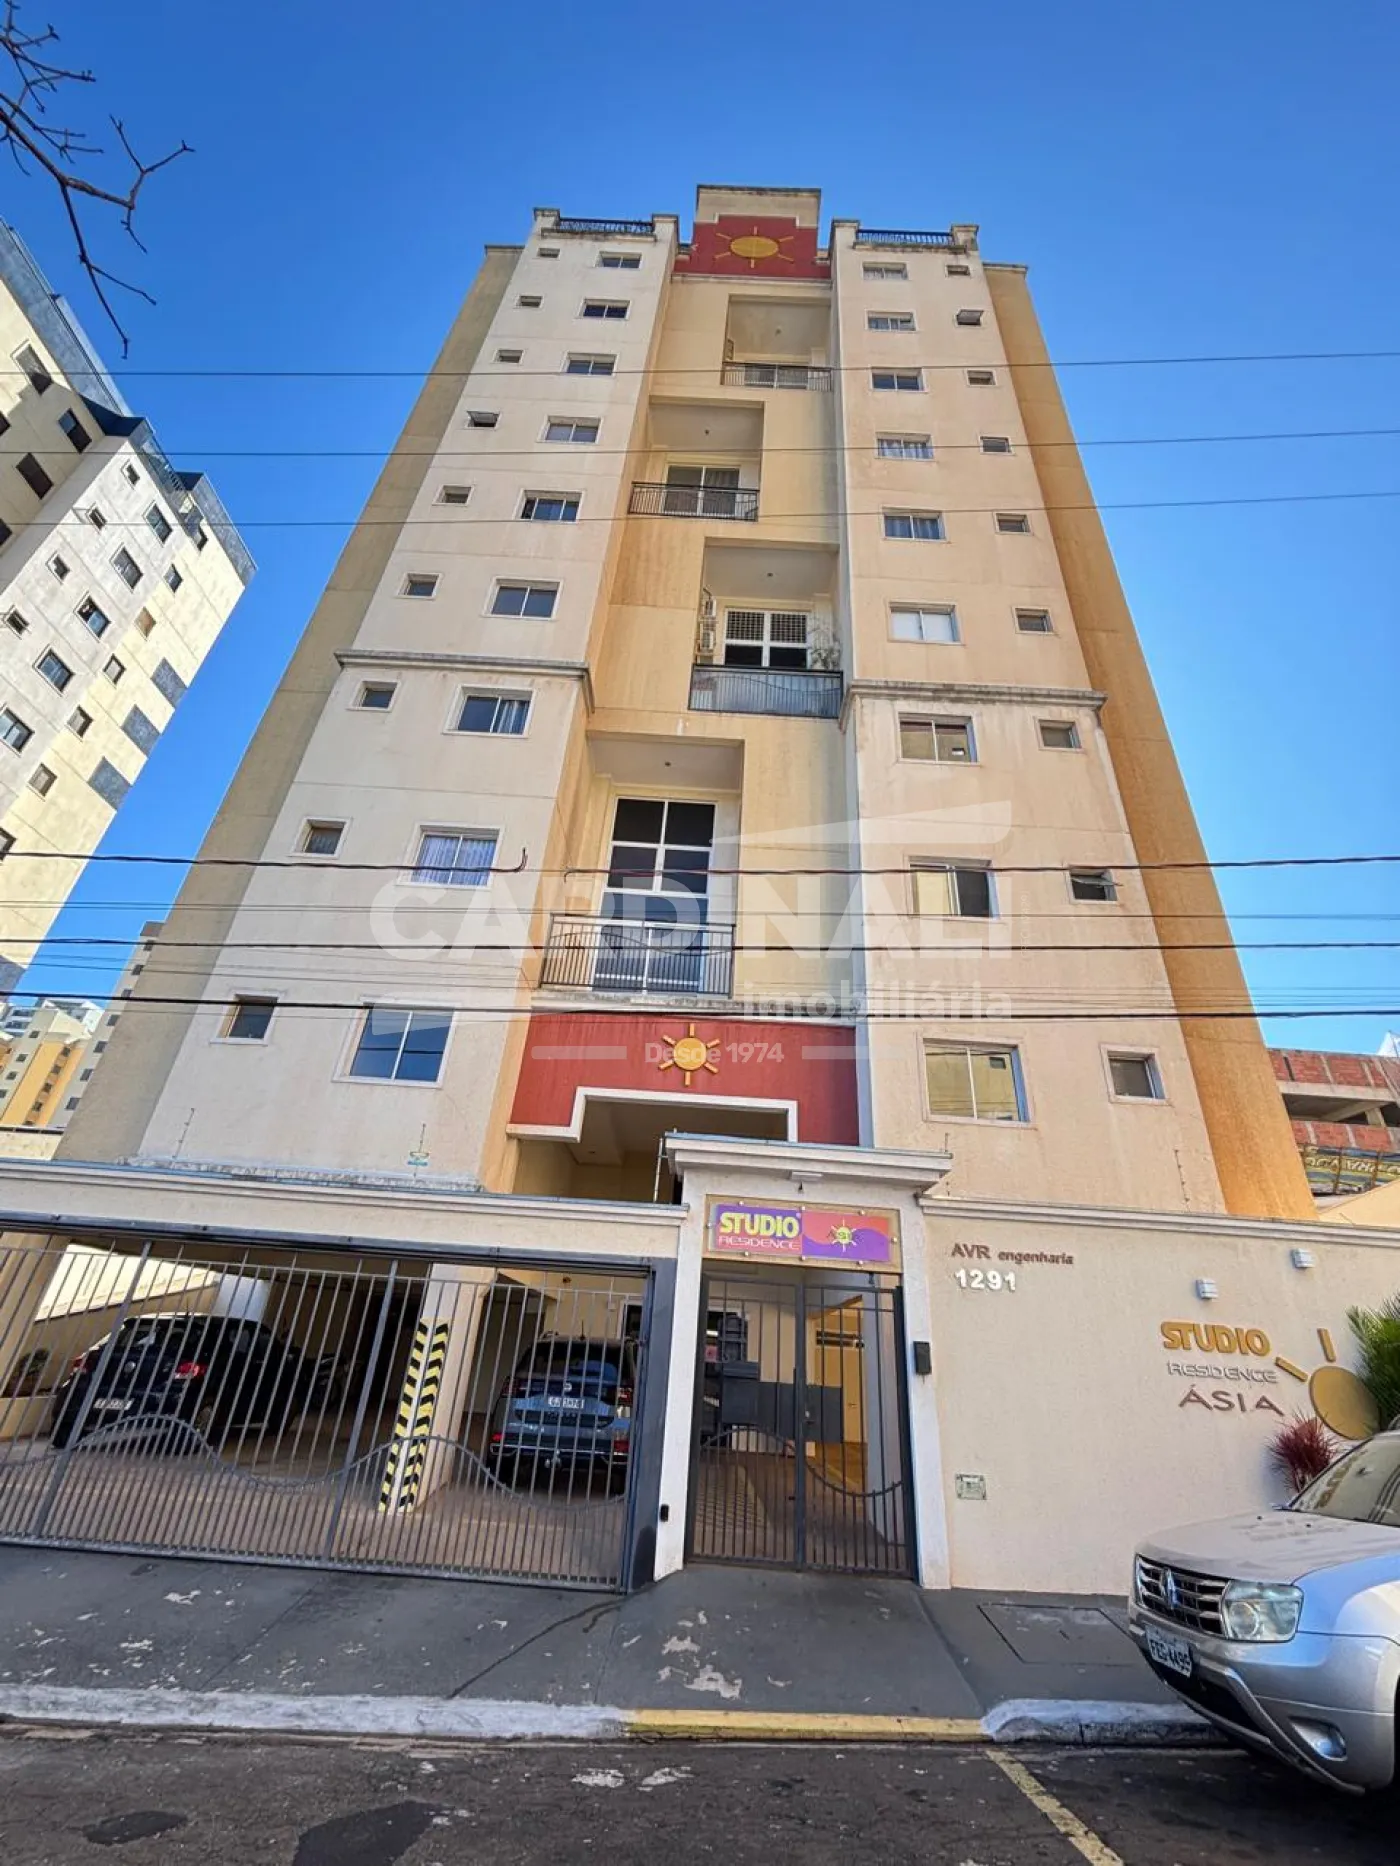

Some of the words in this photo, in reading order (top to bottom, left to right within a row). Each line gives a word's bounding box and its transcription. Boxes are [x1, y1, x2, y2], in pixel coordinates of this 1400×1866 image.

[719, 1212, 800, 1239] STUDIO
[718, 1236, 800, 1250] RESIDENCE
[951, 1243, 991, 1259] AVR
[997, 1251, 1075, 1265] engenharia
[954, 1267, 1017, 1292] 1291
[1160, 1321, 1271, 1357] STUDIO
[1167, 1360, 1279, 1383] RESIDENCE
[1179, 1384, 1285, 1417] ÁSIA
